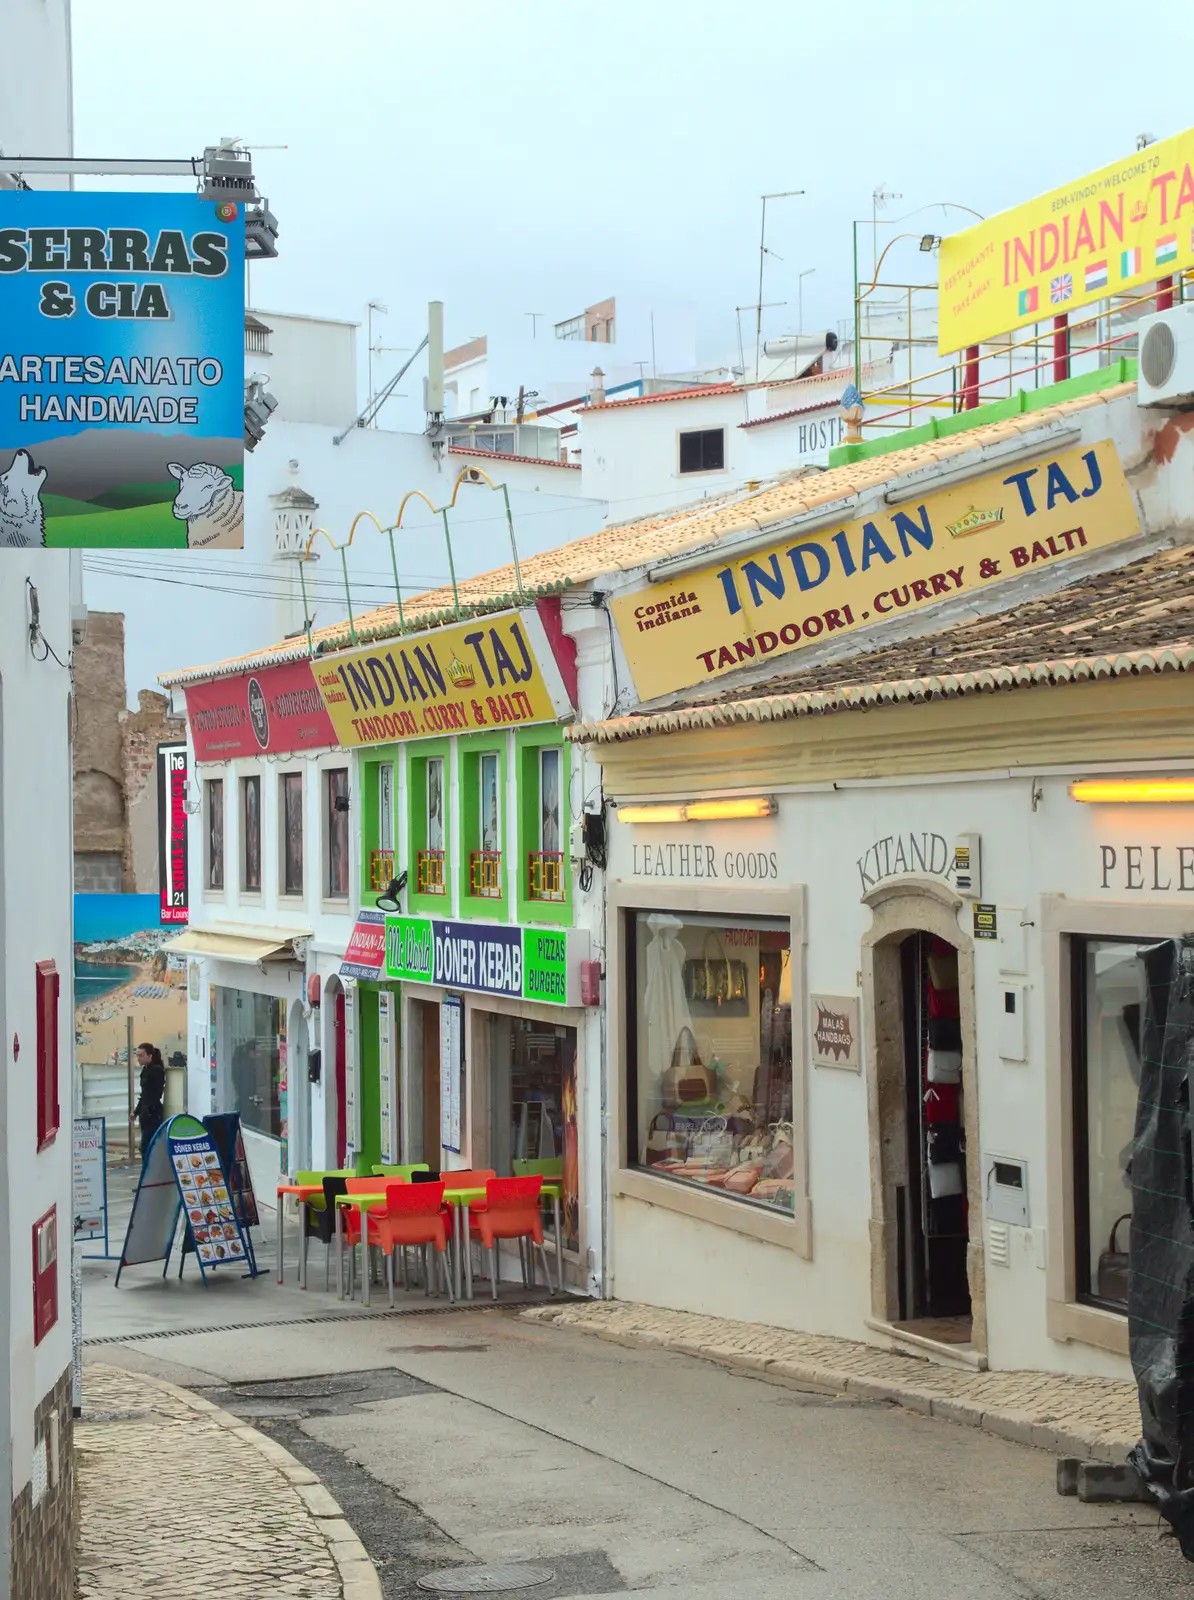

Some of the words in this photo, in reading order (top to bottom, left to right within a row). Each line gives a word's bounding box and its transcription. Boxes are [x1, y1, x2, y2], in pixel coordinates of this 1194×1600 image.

[1103, 161, 1146, 188] WELCOME
[1147, 155, 1160, 170] TO
[0, 228, 229, 277] SERRAS
[1002, 192, 1125, 287] INDIAN
[38, 280, 76, 318] &
[85, 281, 171, 319] CIA
[952, 295, 971, 317] TAKE
[0, 355, 223, 386] ARTESANATO
[20, 395, 198, 423] HANDMADE
[716, 504, 935, 616] INDIAN
[1003, 450, 1103, 517] TAJ
[873, 566, 965, 613] CURRY
[979, 557, 1003, 579] &
[1009, 526, 1088, 568] BALTI
[634, 591, 698, 620] Comida
[636, 603, 702, 633] Indiana
[318, 671, 340, 687] Comida
[337, 643, 447, 713] INDIAN
[464, 622, 532, 688] TAJ
[423, 701, 468, 732] CURRY
[470, 699, 488, 725] &
[485, 691, 534, 723] BALTI
[632, 844, 718, 878] LEATHER
[724, 852, 778, 879] GOODS
[1099, 845, 1194, 891] PELE
[161, 909, 172, 919] Bar
[174, 892, 184, 906] 21
[436, 926, 476, 985] DÖNER
[479, 941, 522, 992] KEBAB
[537, 938, 565, 962] PIZZAS
[529, 969, 566, 996] BURGERS
[817, 1031, 852, 1045] HANDBAGS
[822, 1017, 845, 1031] MALAS
[173, 1144, 192, 1153] DÖNER
[192, 1142, 211, 1152] KEBAB
